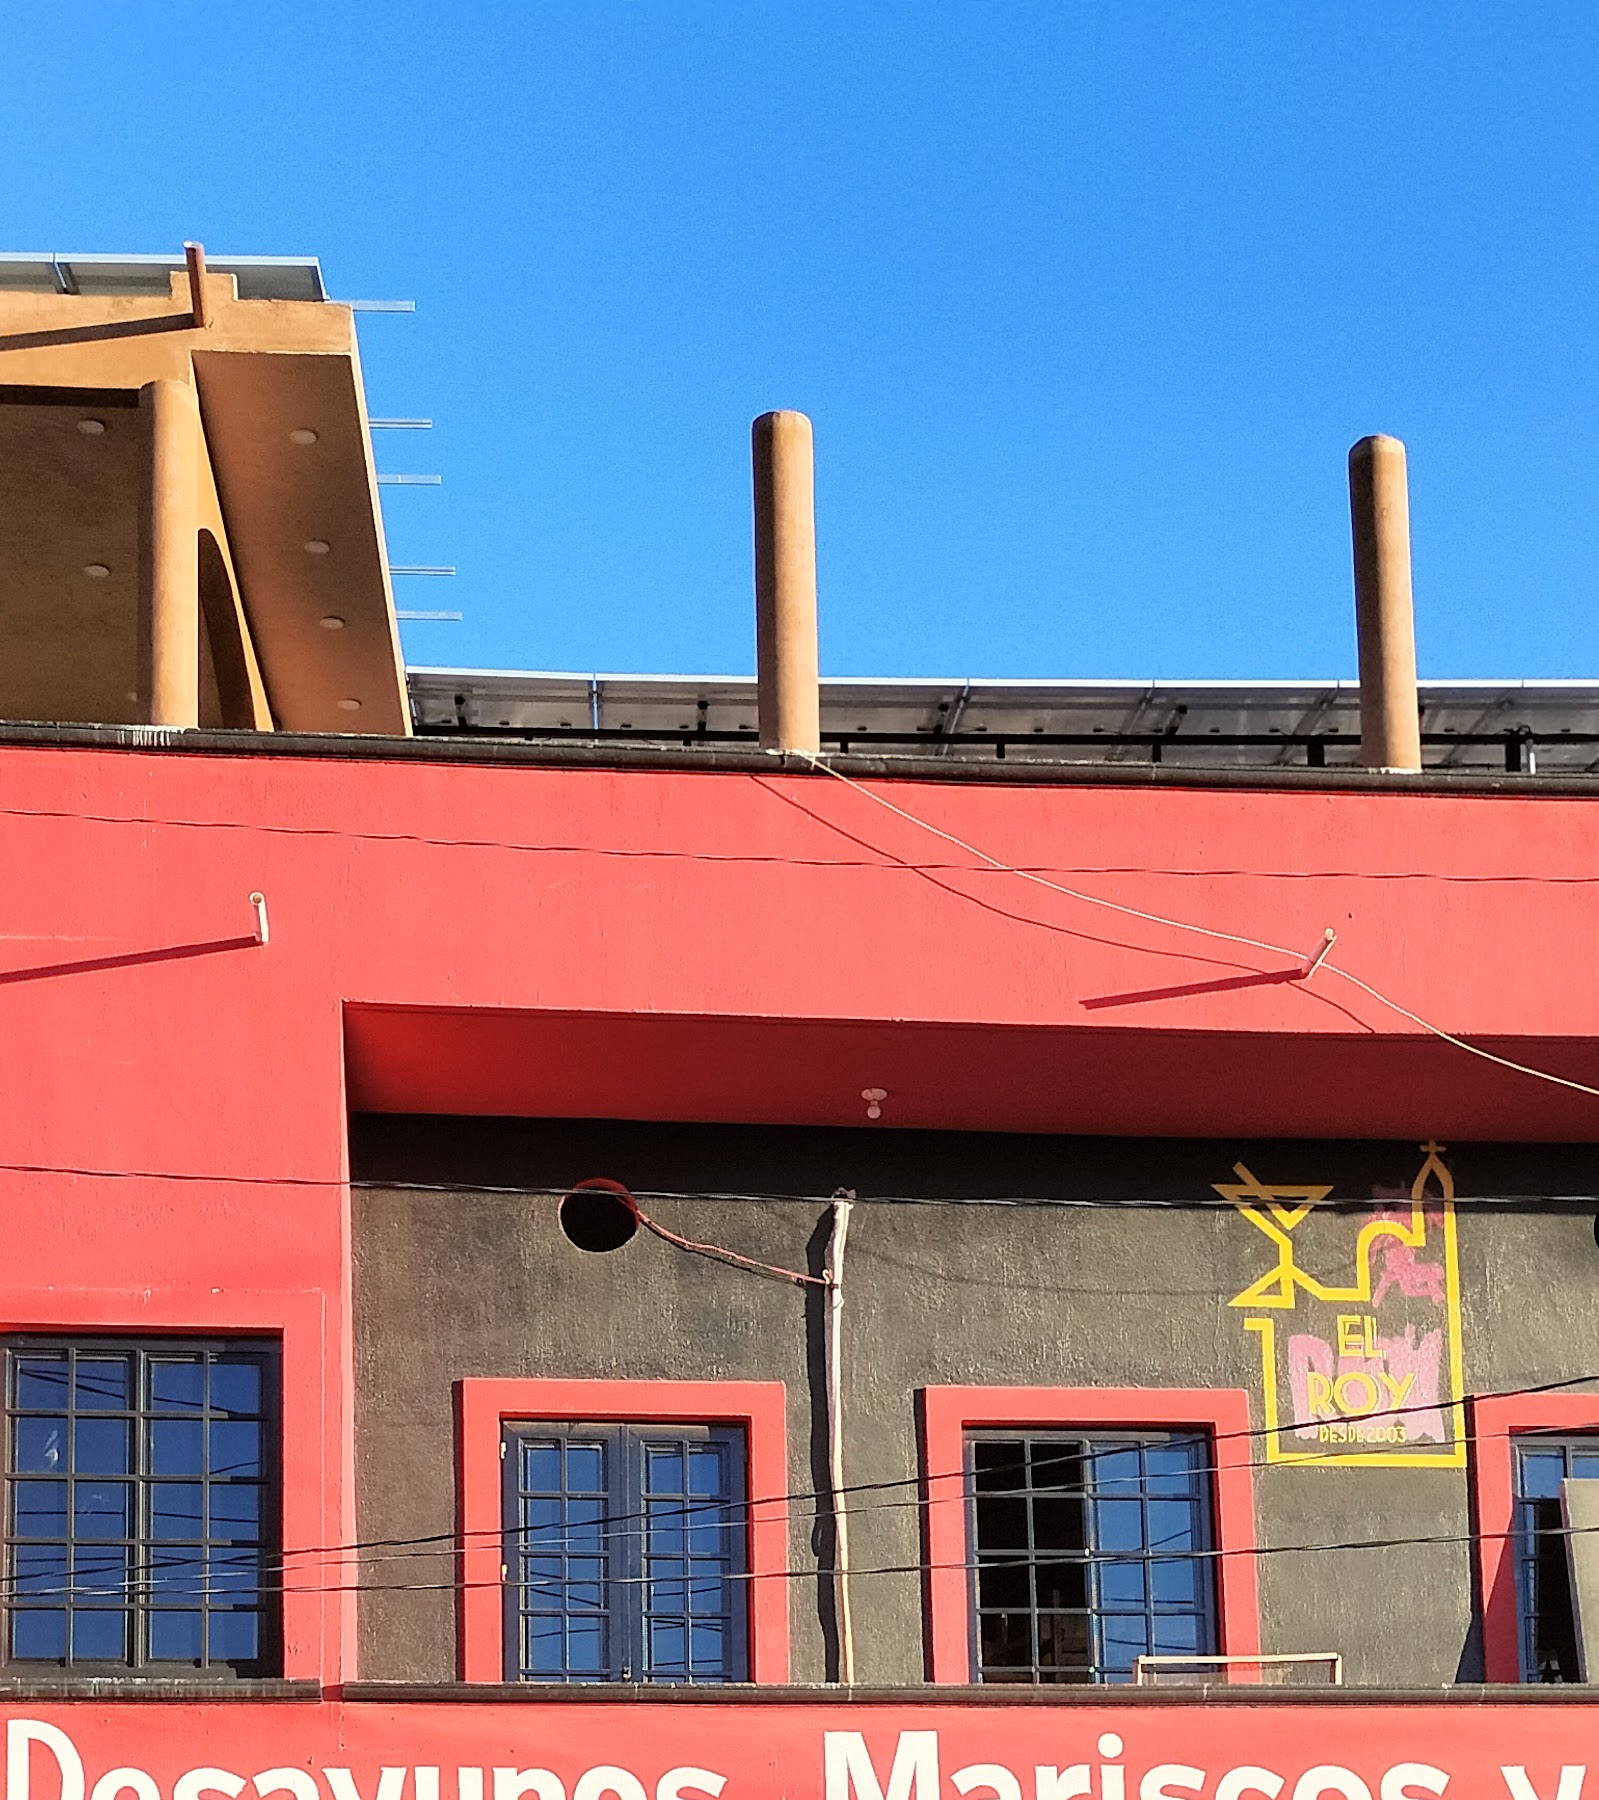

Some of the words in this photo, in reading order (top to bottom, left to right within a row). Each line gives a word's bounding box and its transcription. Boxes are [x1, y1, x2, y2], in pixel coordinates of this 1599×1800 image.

[1336, 1315, 1386, 1358] EL
[1306, 1371, 1416, 1417] ROY
[1319, 1425, 1364, 1443] DESDE
[1366, 1425, 1407, 1443] 2003
